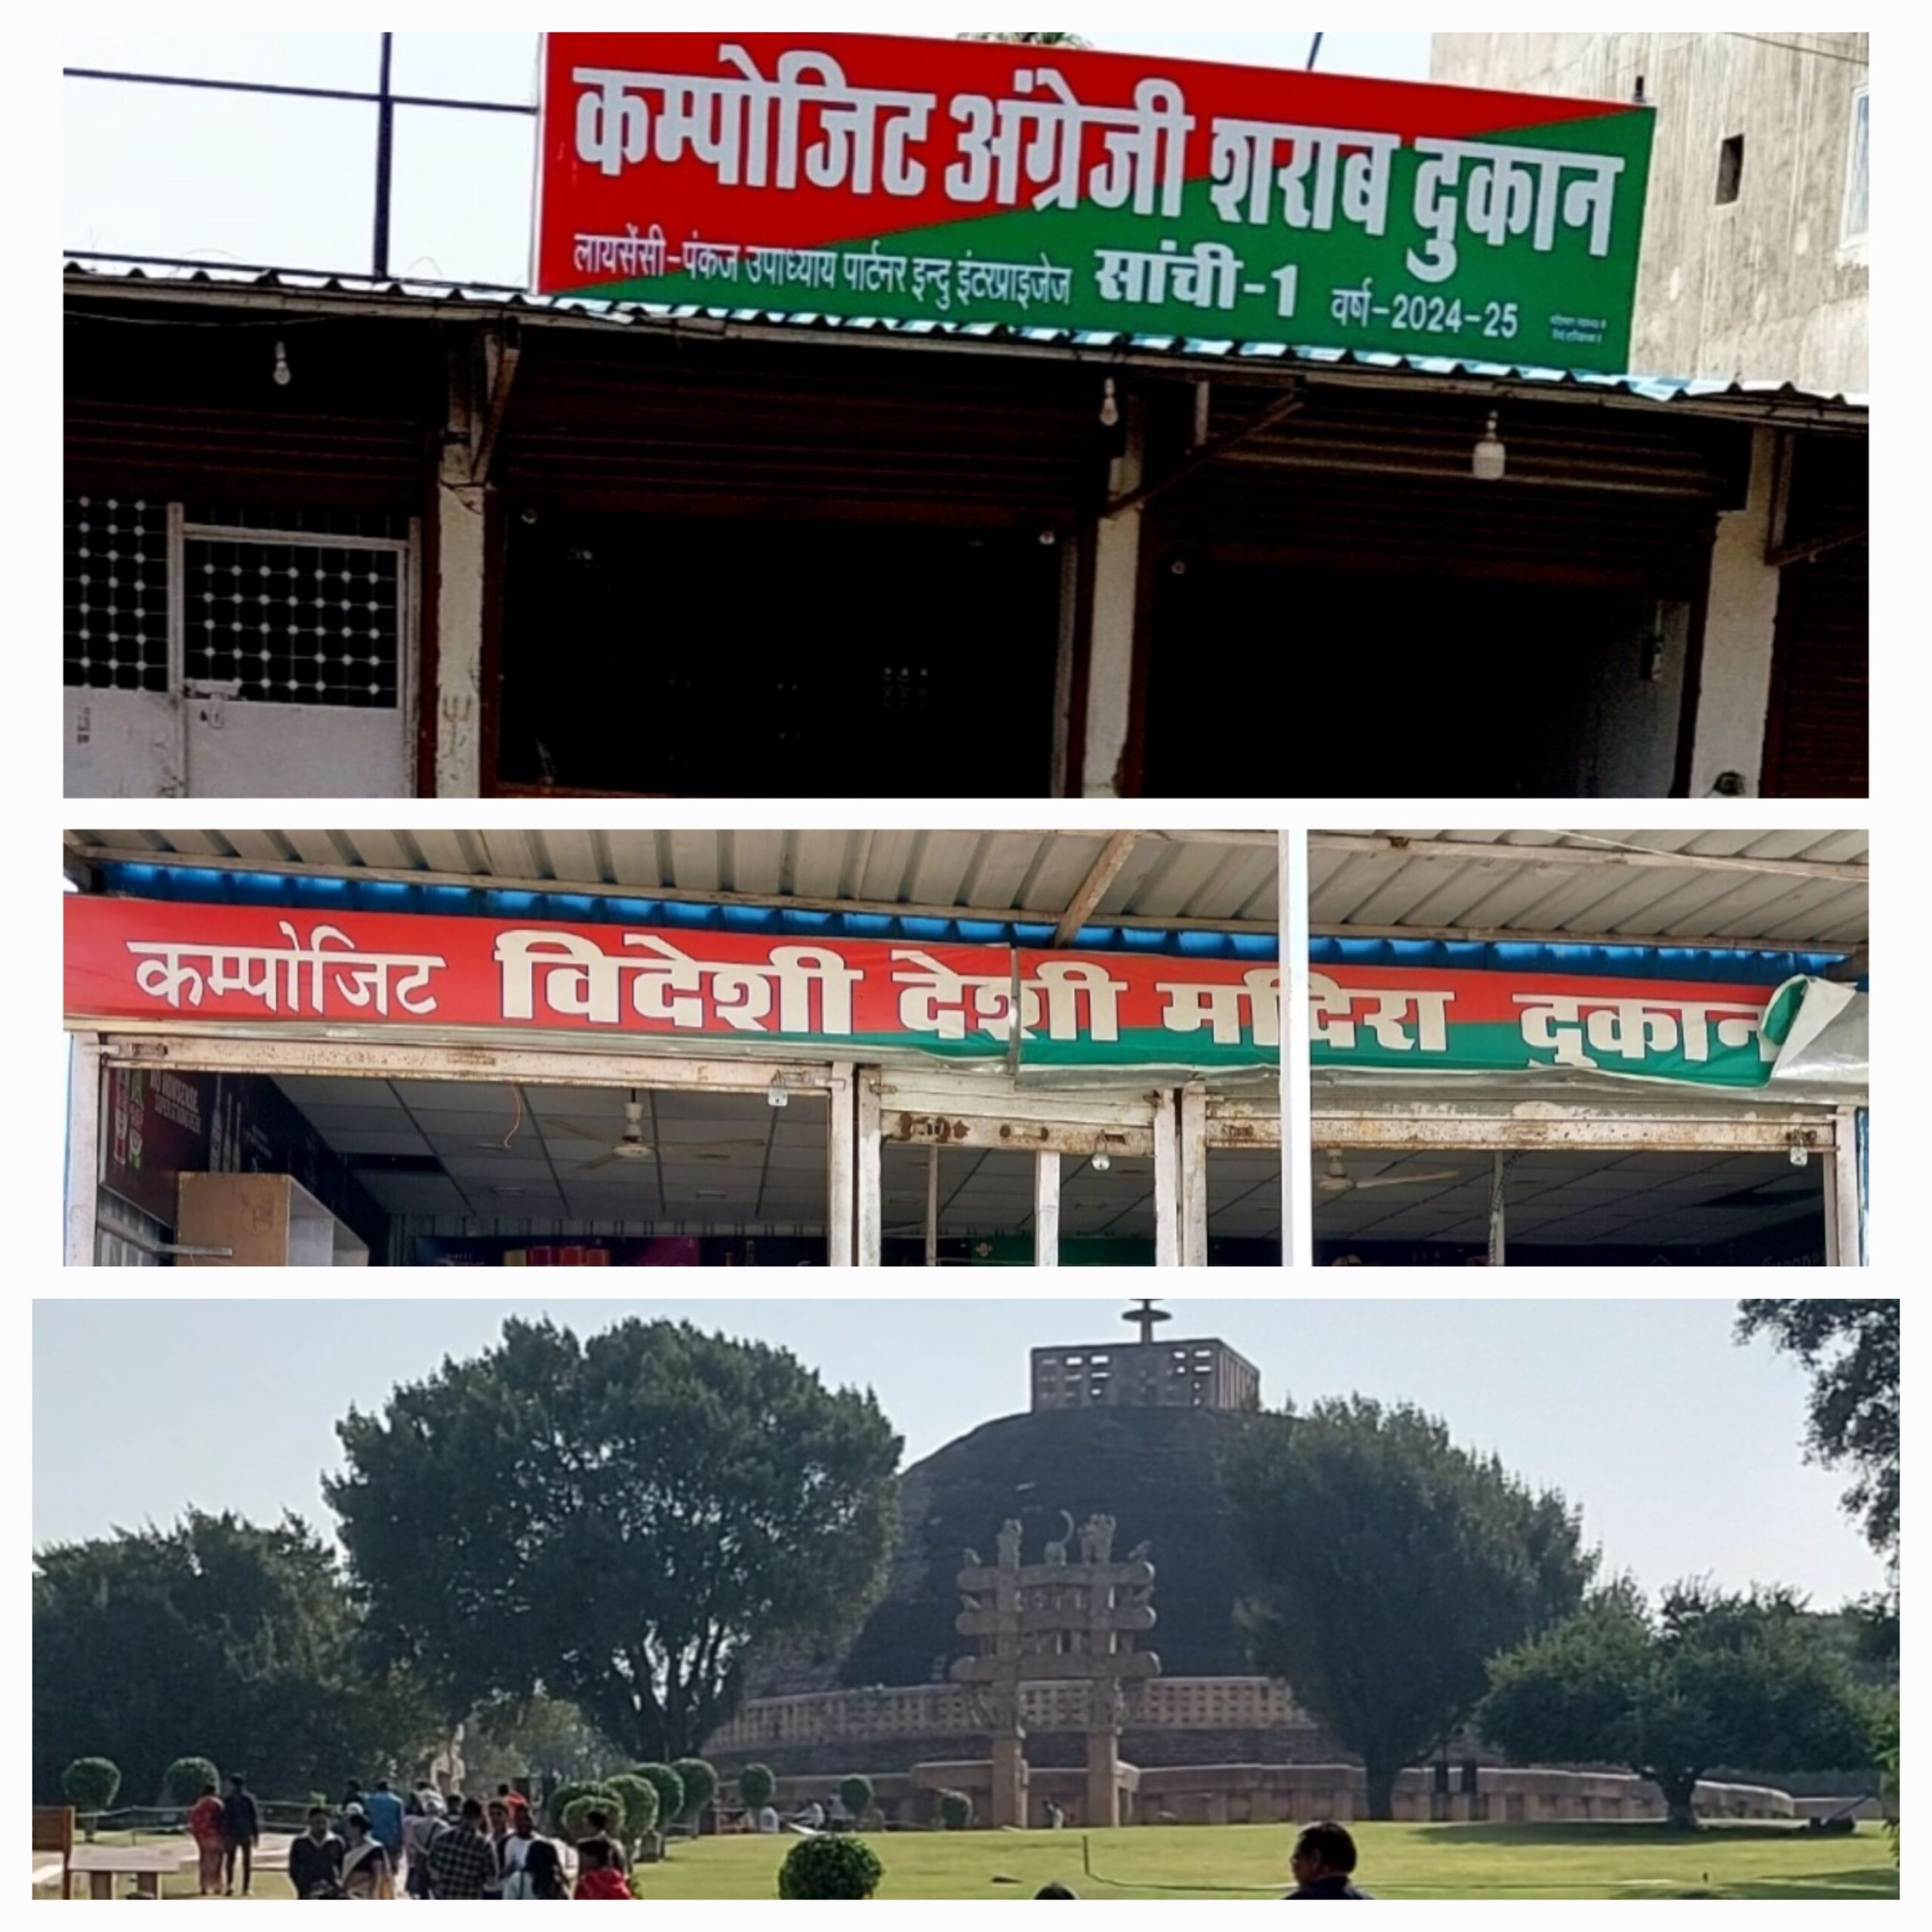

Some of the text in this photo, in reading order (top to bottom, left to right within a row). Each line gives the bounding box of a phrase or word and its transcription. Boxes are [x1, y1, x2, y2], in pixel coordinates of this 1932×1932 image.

[572, 44, 1625, 283] कम्पोजिट अंग्रेजी शराब दुकान
[745, 245, 837, 289] उपाध्याय
[843, 239, 906, 293] पार्टनर
[912, 257, 952, 310] इन्दु
[1094, 239, 1299, 318] सांची-1
[126, 919, 1780, 1069] कम्पोजिट विदेशी देशी मदिरा दुकान
